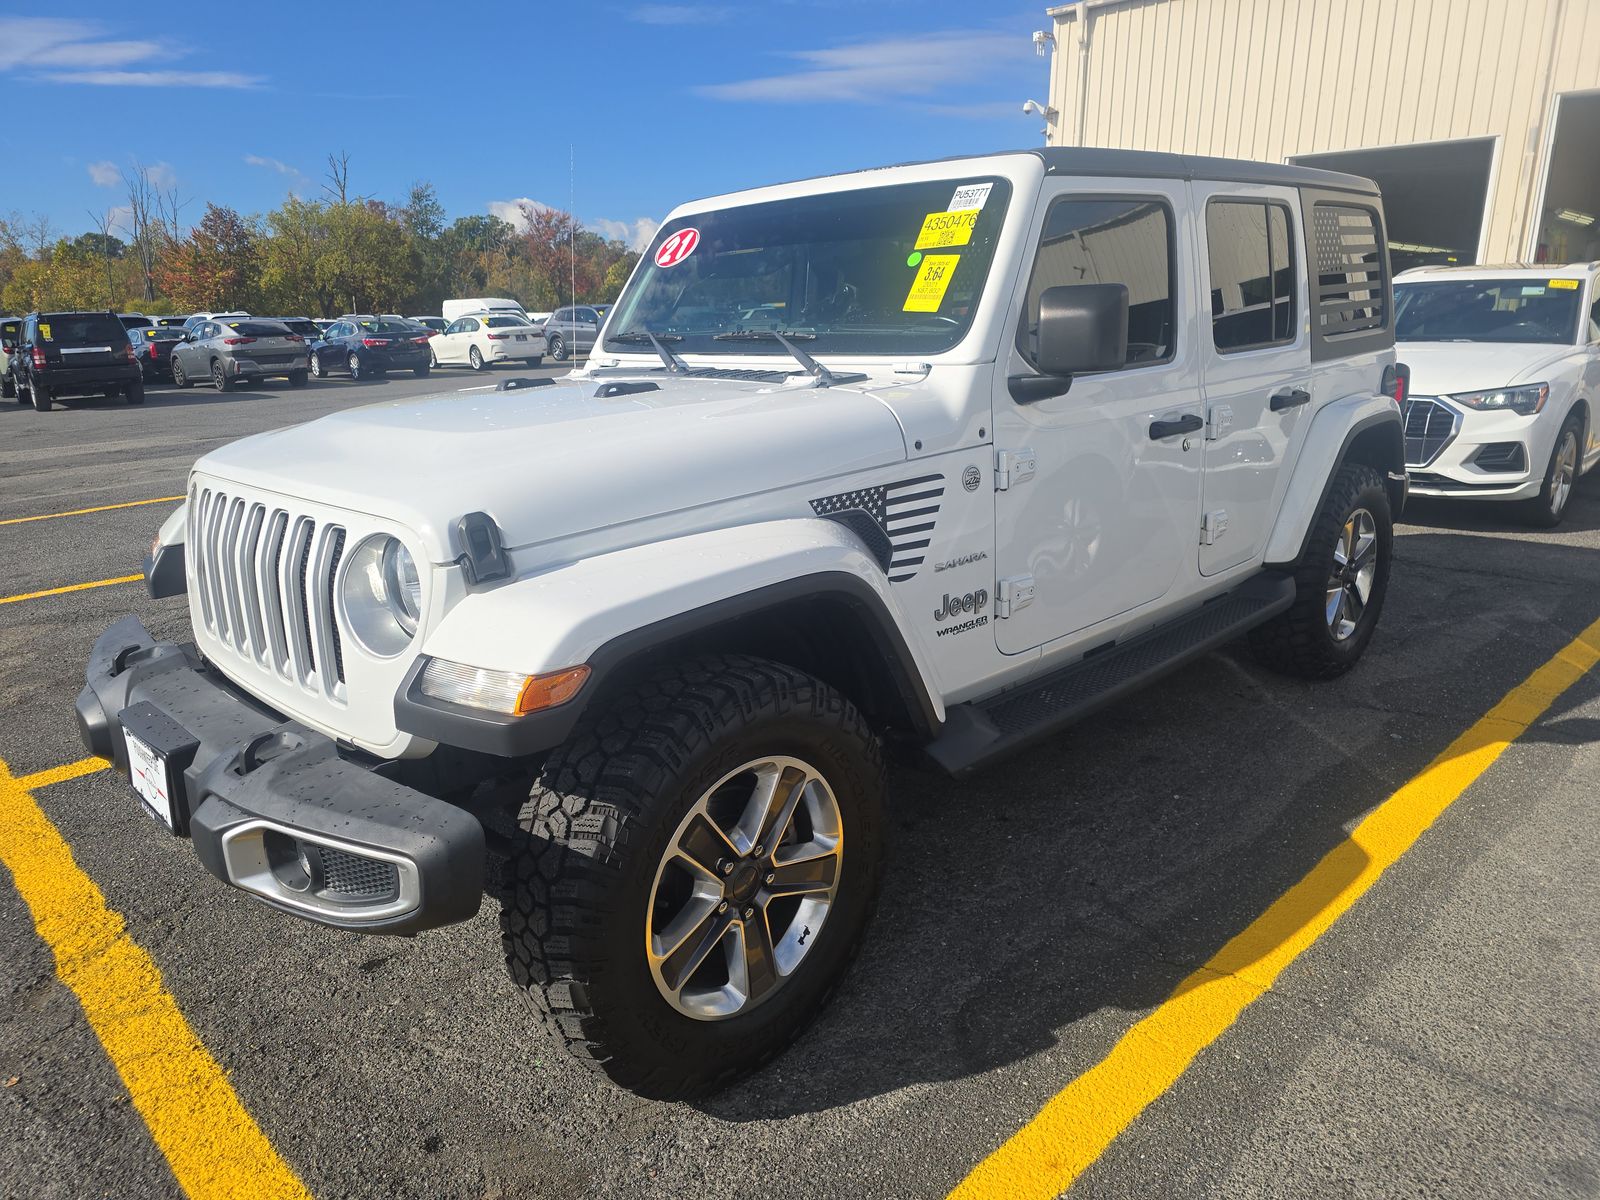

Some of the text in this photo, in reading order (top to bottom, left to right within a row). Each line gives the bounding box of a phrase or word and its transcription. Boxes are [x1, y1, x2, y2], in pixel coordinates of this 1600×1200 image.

[954, 188, 990, 199] PU5377T
[925, 212, 978, 231] 4350476
[658, 231, 695, 264] 21
[934, 551, 989, 573] SAHARA
[934, 588, 989, 621] Jeep
[936, 615, 988, 637] WRANGLER
